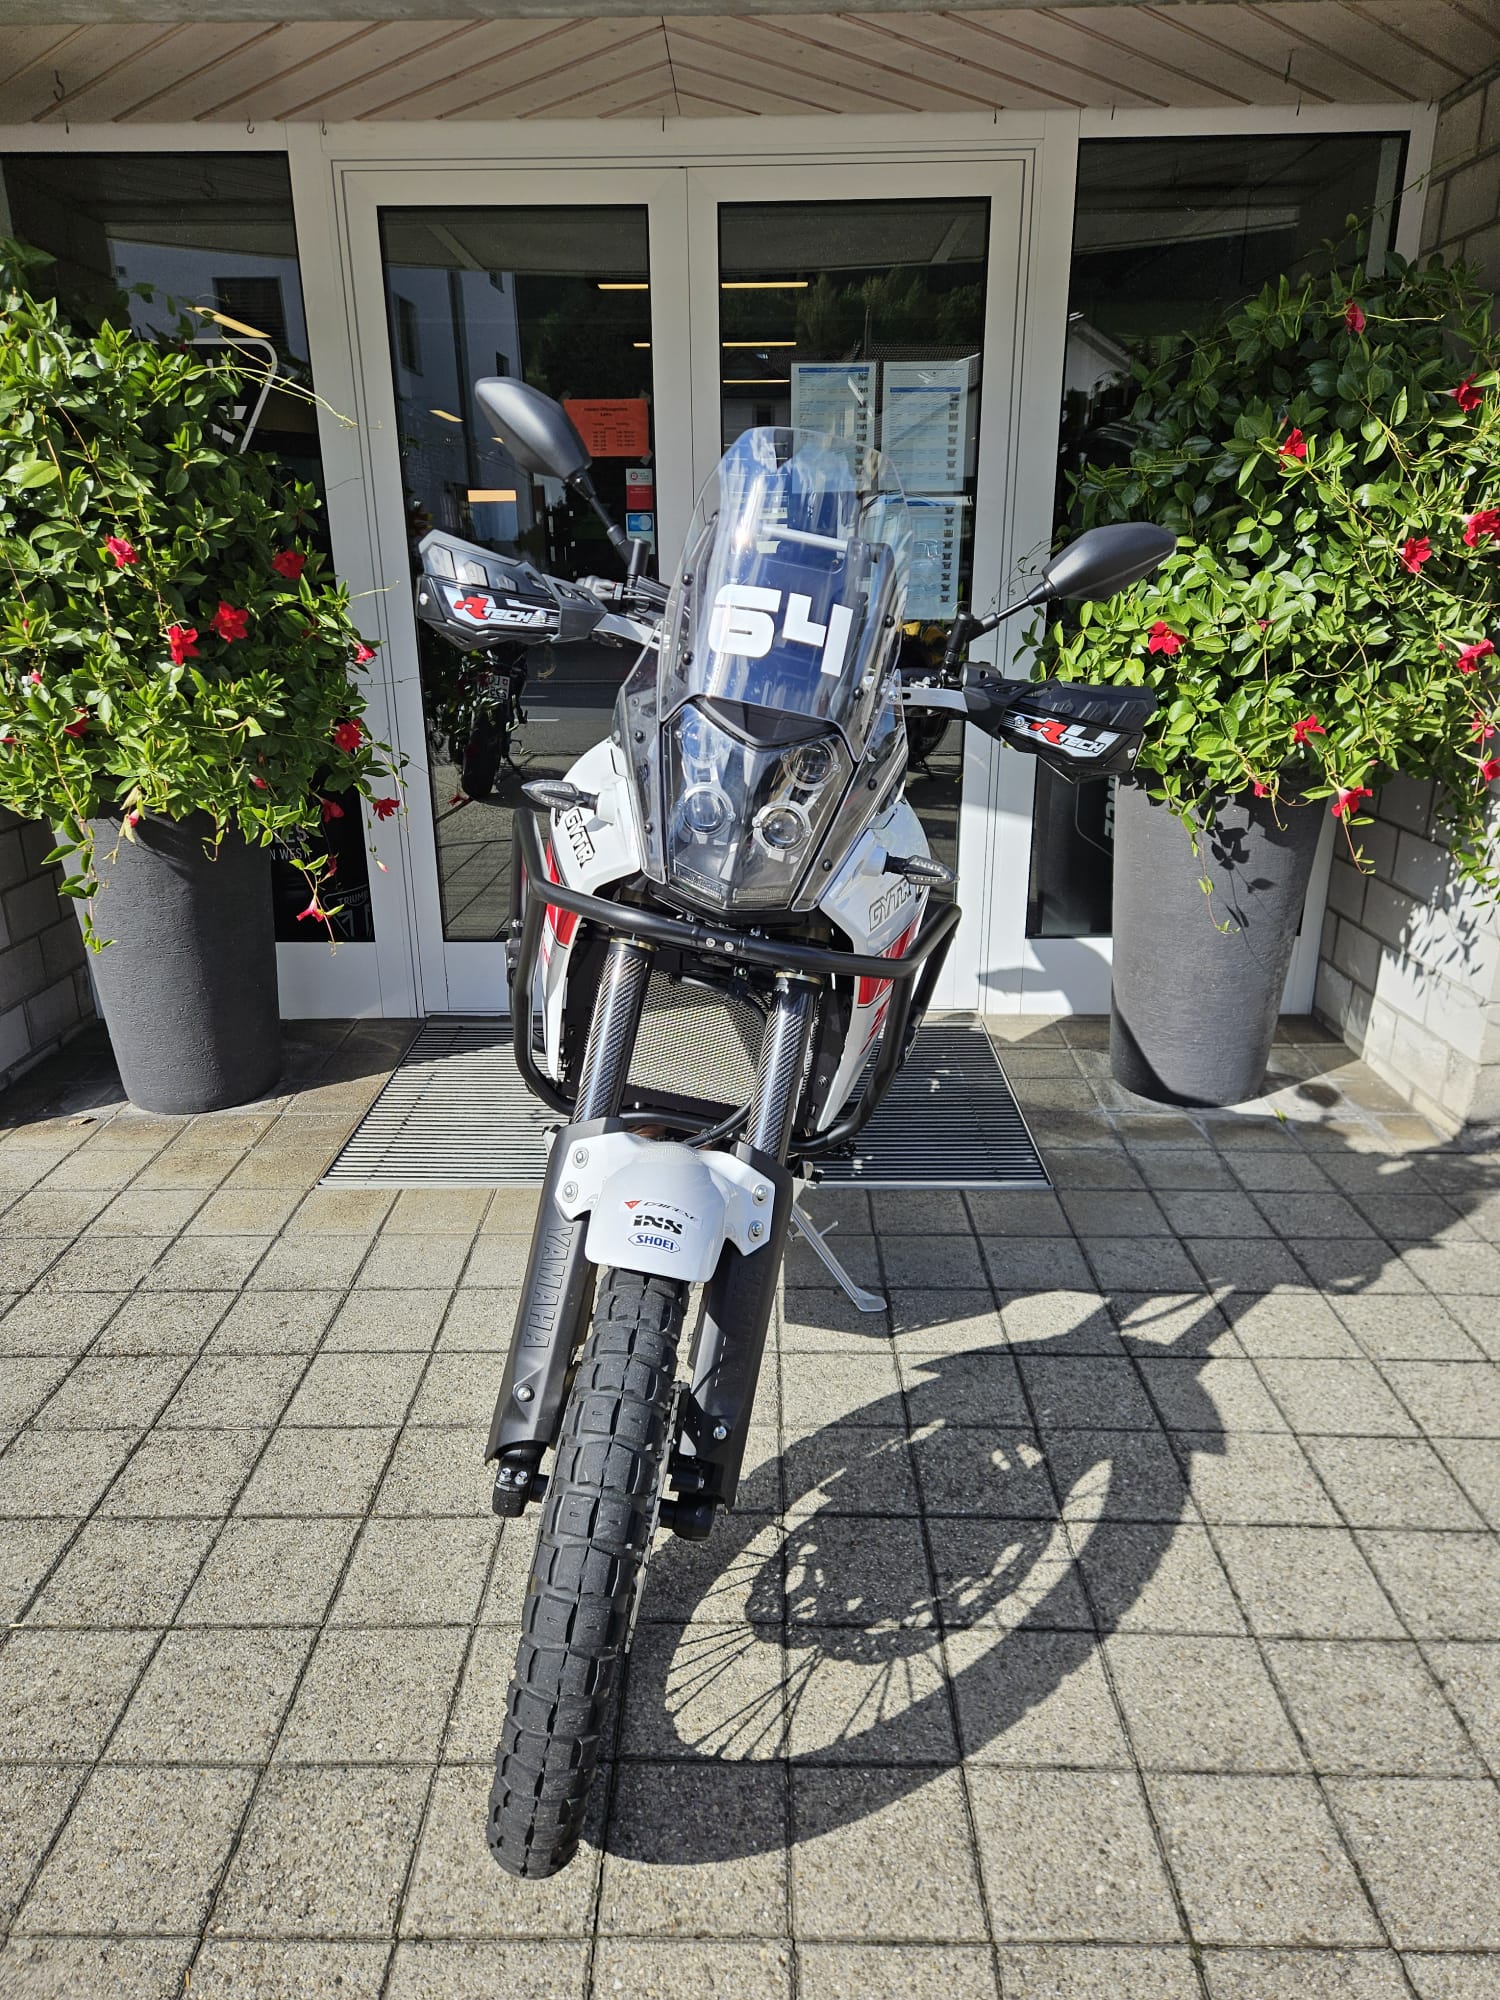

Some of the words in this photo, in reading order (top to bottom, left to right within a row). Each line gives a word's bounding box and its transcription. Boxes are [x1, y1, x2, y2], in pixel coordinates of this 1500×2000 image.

[708, 584, 853, 677] 64
[523, 1226, 574, 1347] YAMAHA
[636, 1234, 675, 1251] SHOEI
